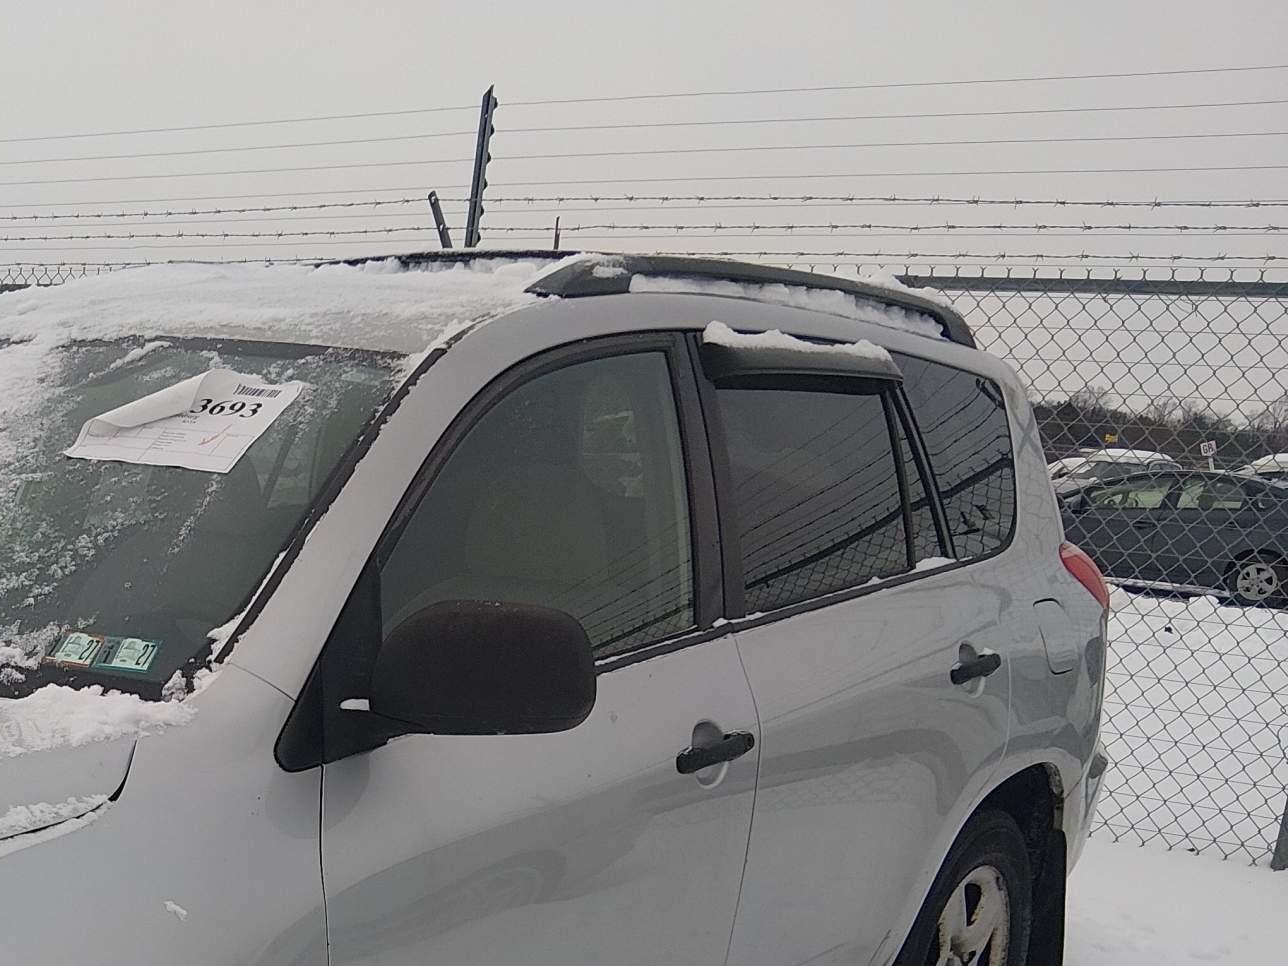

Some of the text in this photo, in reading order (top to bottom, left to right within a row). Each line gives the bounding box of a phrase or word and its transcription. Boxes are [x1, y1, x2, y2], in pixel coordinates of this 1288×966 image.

[189, 398, 263, 418] 3693
[78, 640, 101, 663] 27
[135, 643, 157, 666] 27
